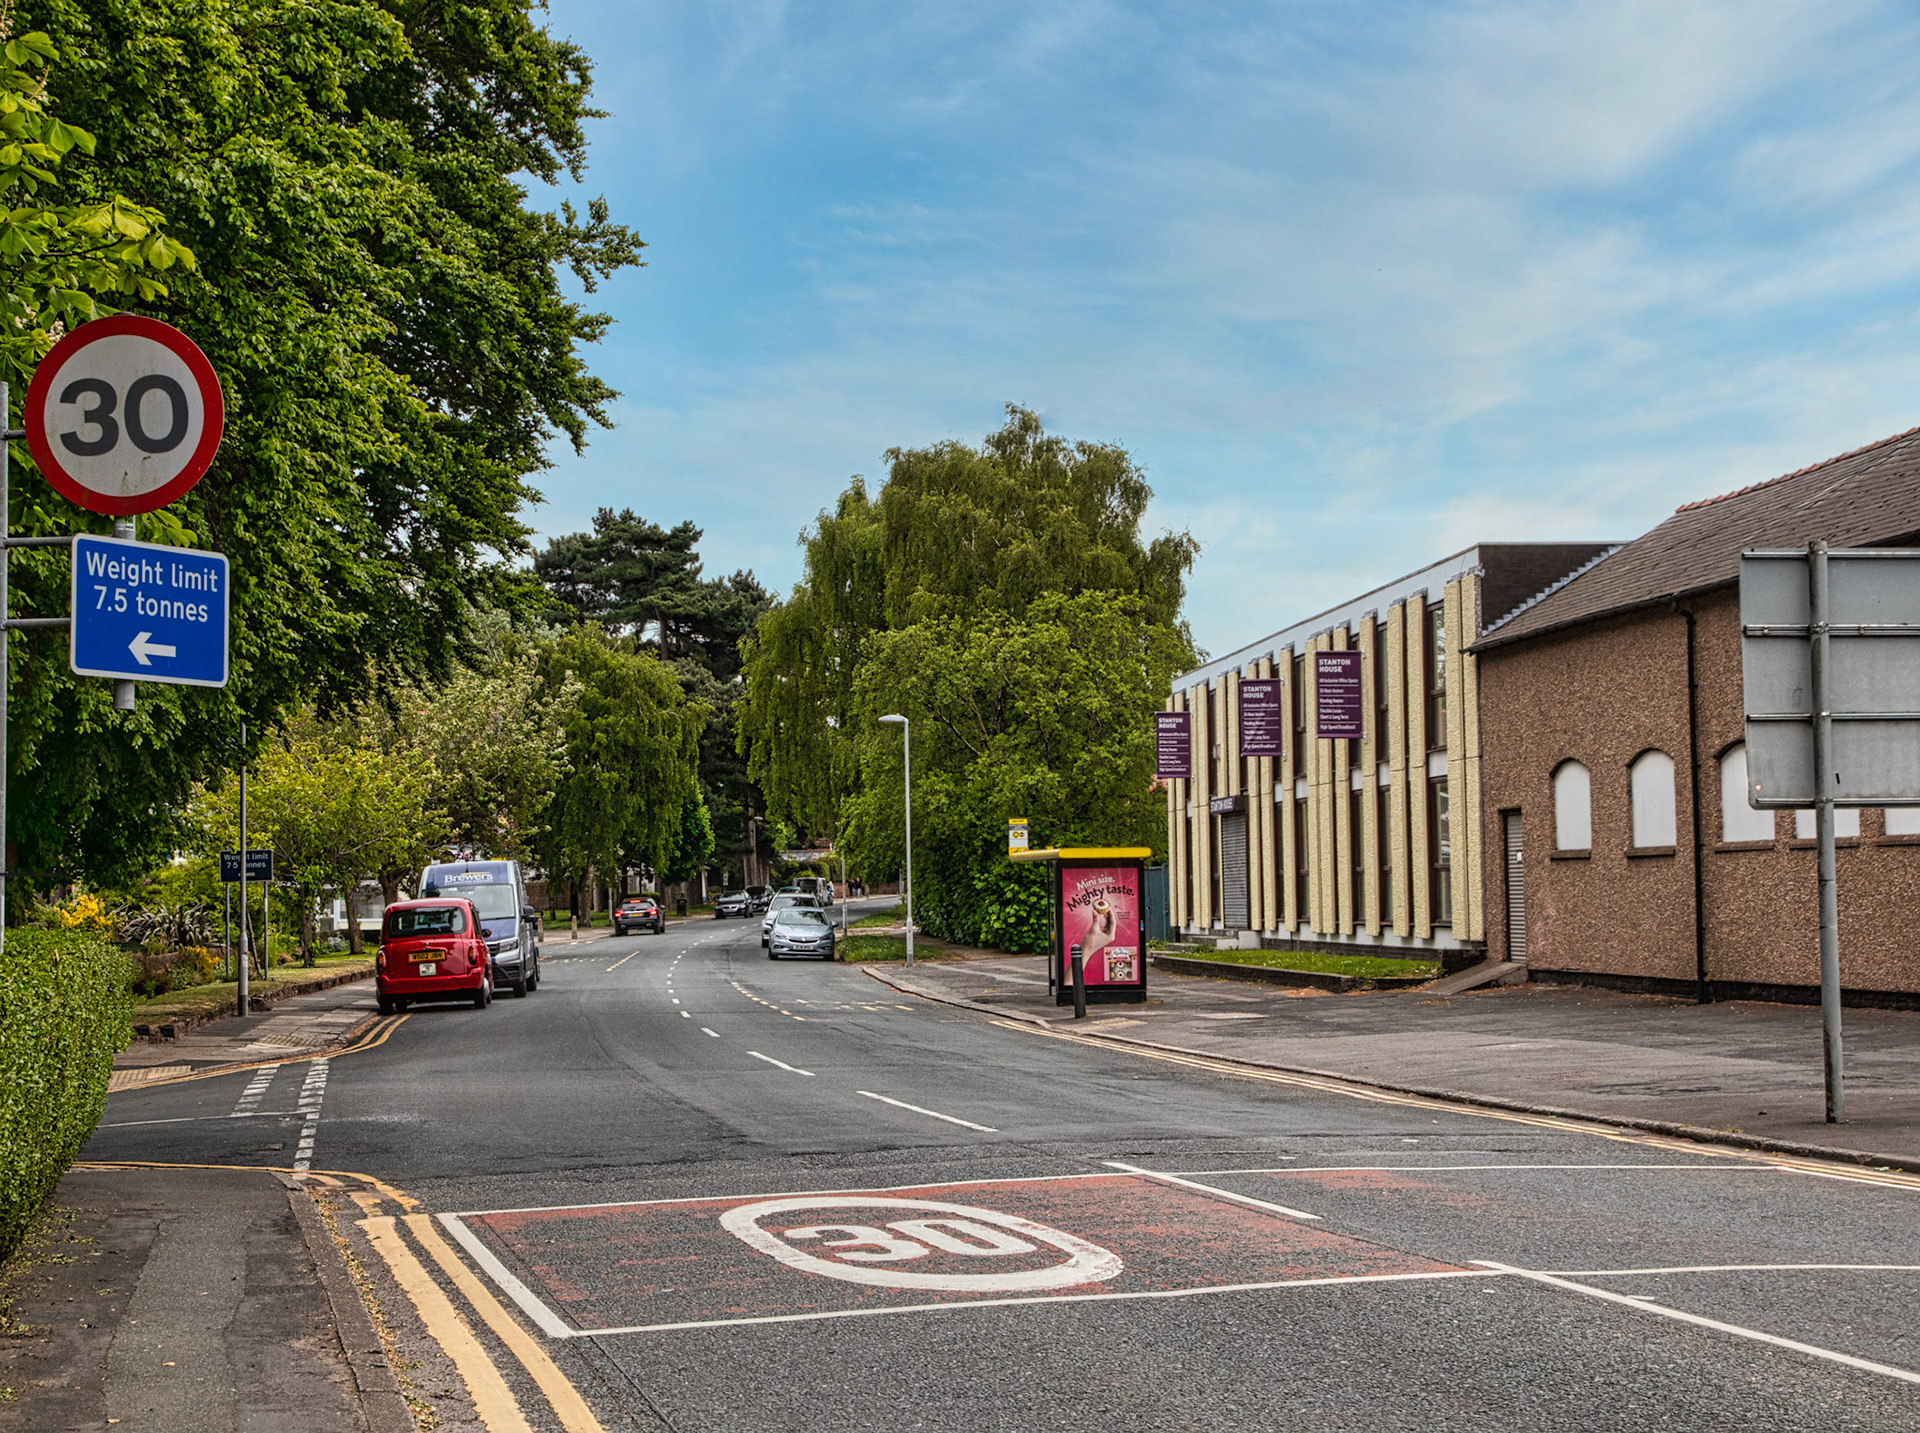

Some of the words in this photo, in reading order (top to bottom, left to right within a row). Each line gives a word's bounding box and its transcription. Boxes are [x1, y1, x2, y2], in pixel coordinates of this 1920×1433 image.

[60, 374, 189, 456] 30
[86, 551, 163, 587] Weight
[171, 563, 218, 592] limit
[93, 585, 128, 613] 7.5
[136, 591, 209, 623] tonnes
[444, 874, 494, 883] Brewers
[1076, 876, 1097, 890] Mini
[1098, 874, 1115, 884] size.
[1066, 888, 1104, 912] Mighty
[1106, 885, 1135, 896] taste.
[784, 1219, 1038, 1262] 30
